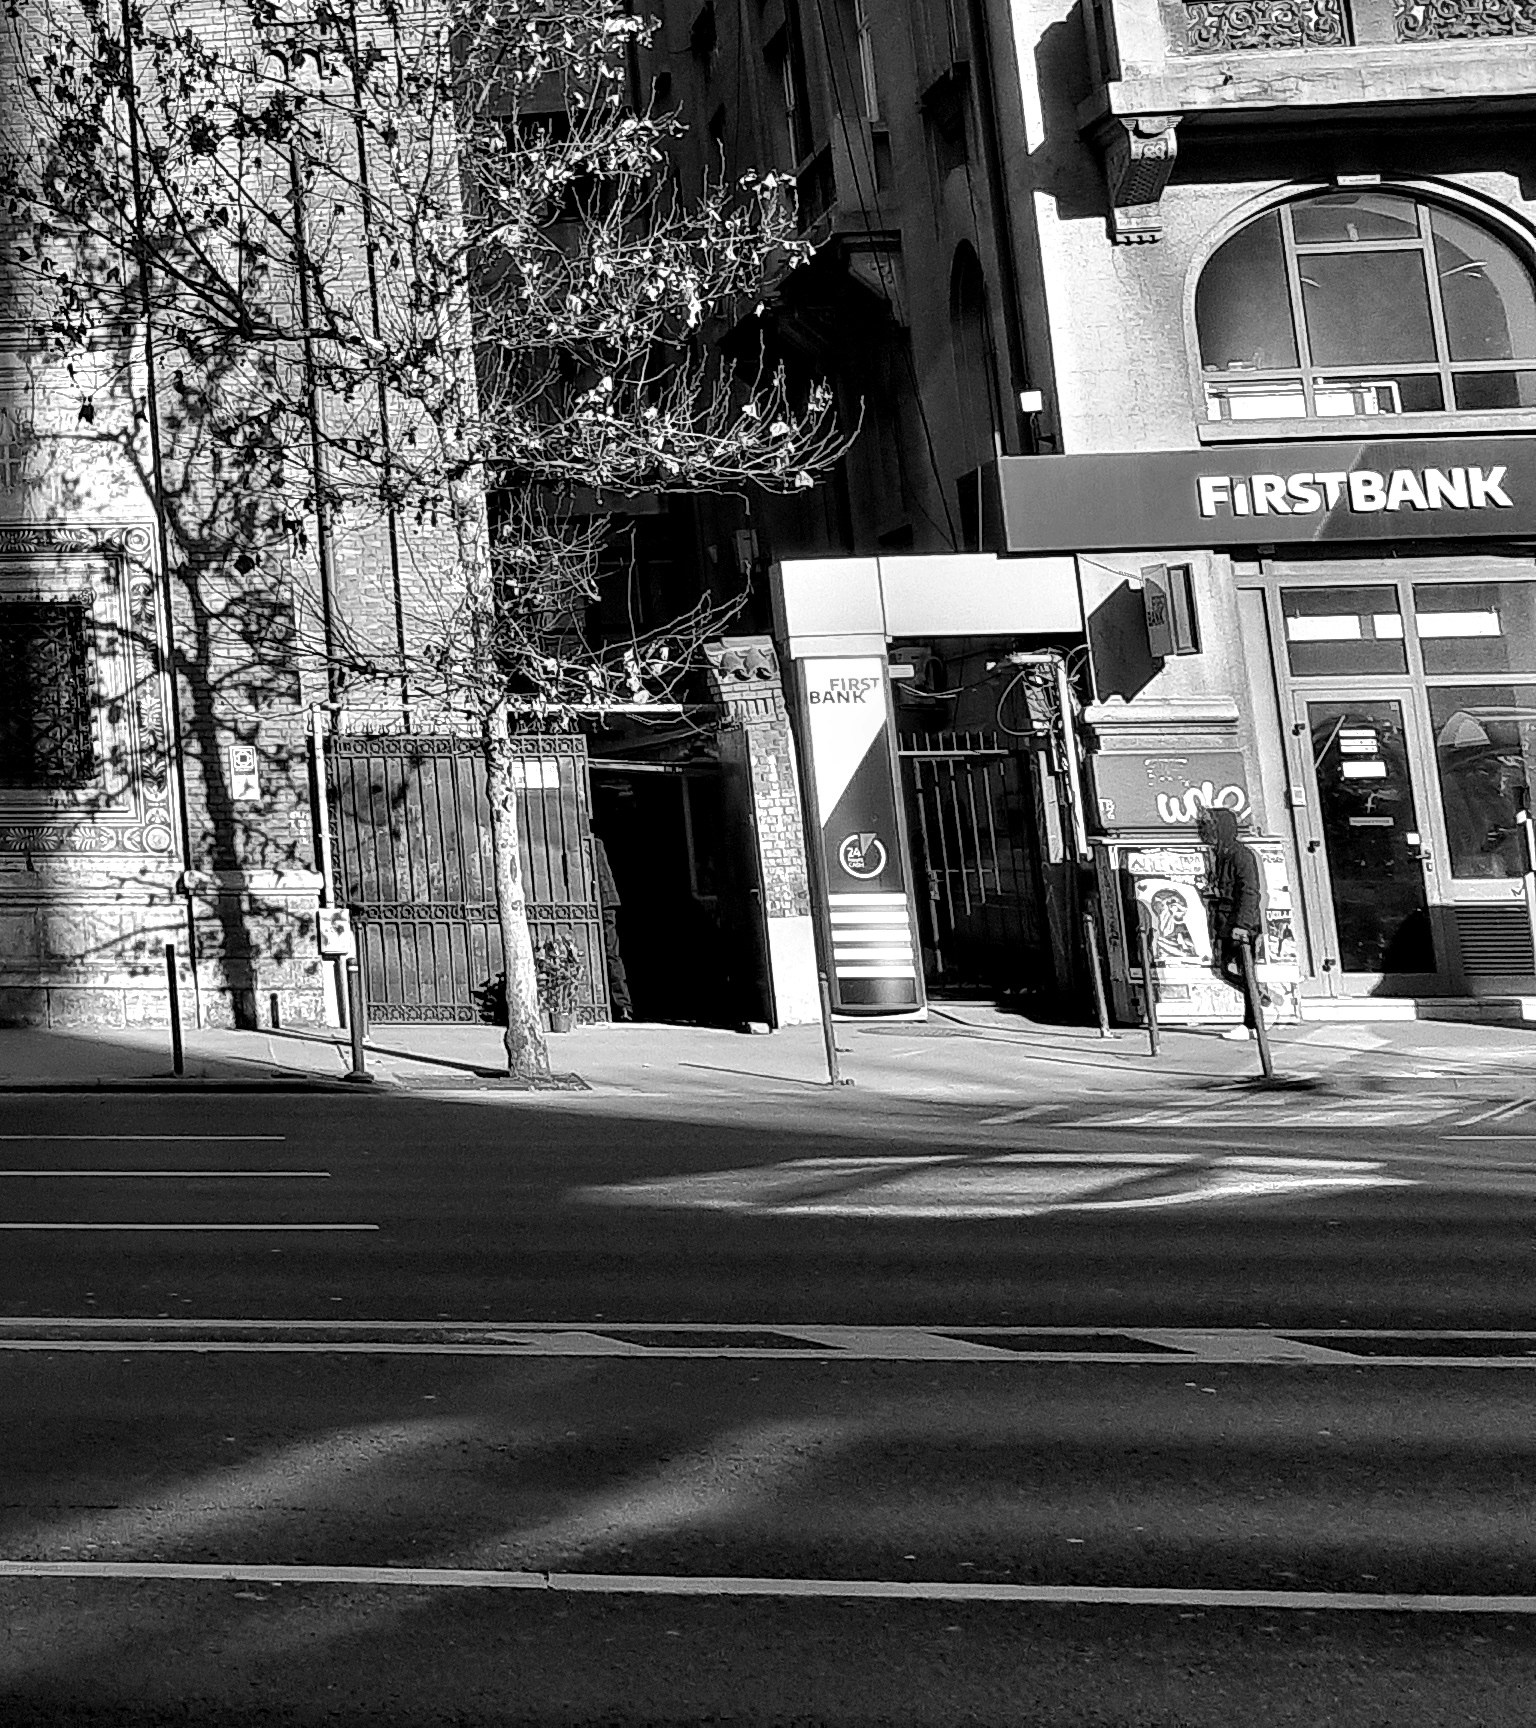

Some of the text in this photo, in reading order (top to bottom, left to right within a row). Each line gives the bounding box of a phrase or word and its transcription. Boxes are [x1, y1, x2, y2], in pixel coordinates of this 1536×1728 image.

[829, 677, 880, 692] FIRST
[808, 690, 867, 705] BANK
[846, 847, 862, 858] 24
